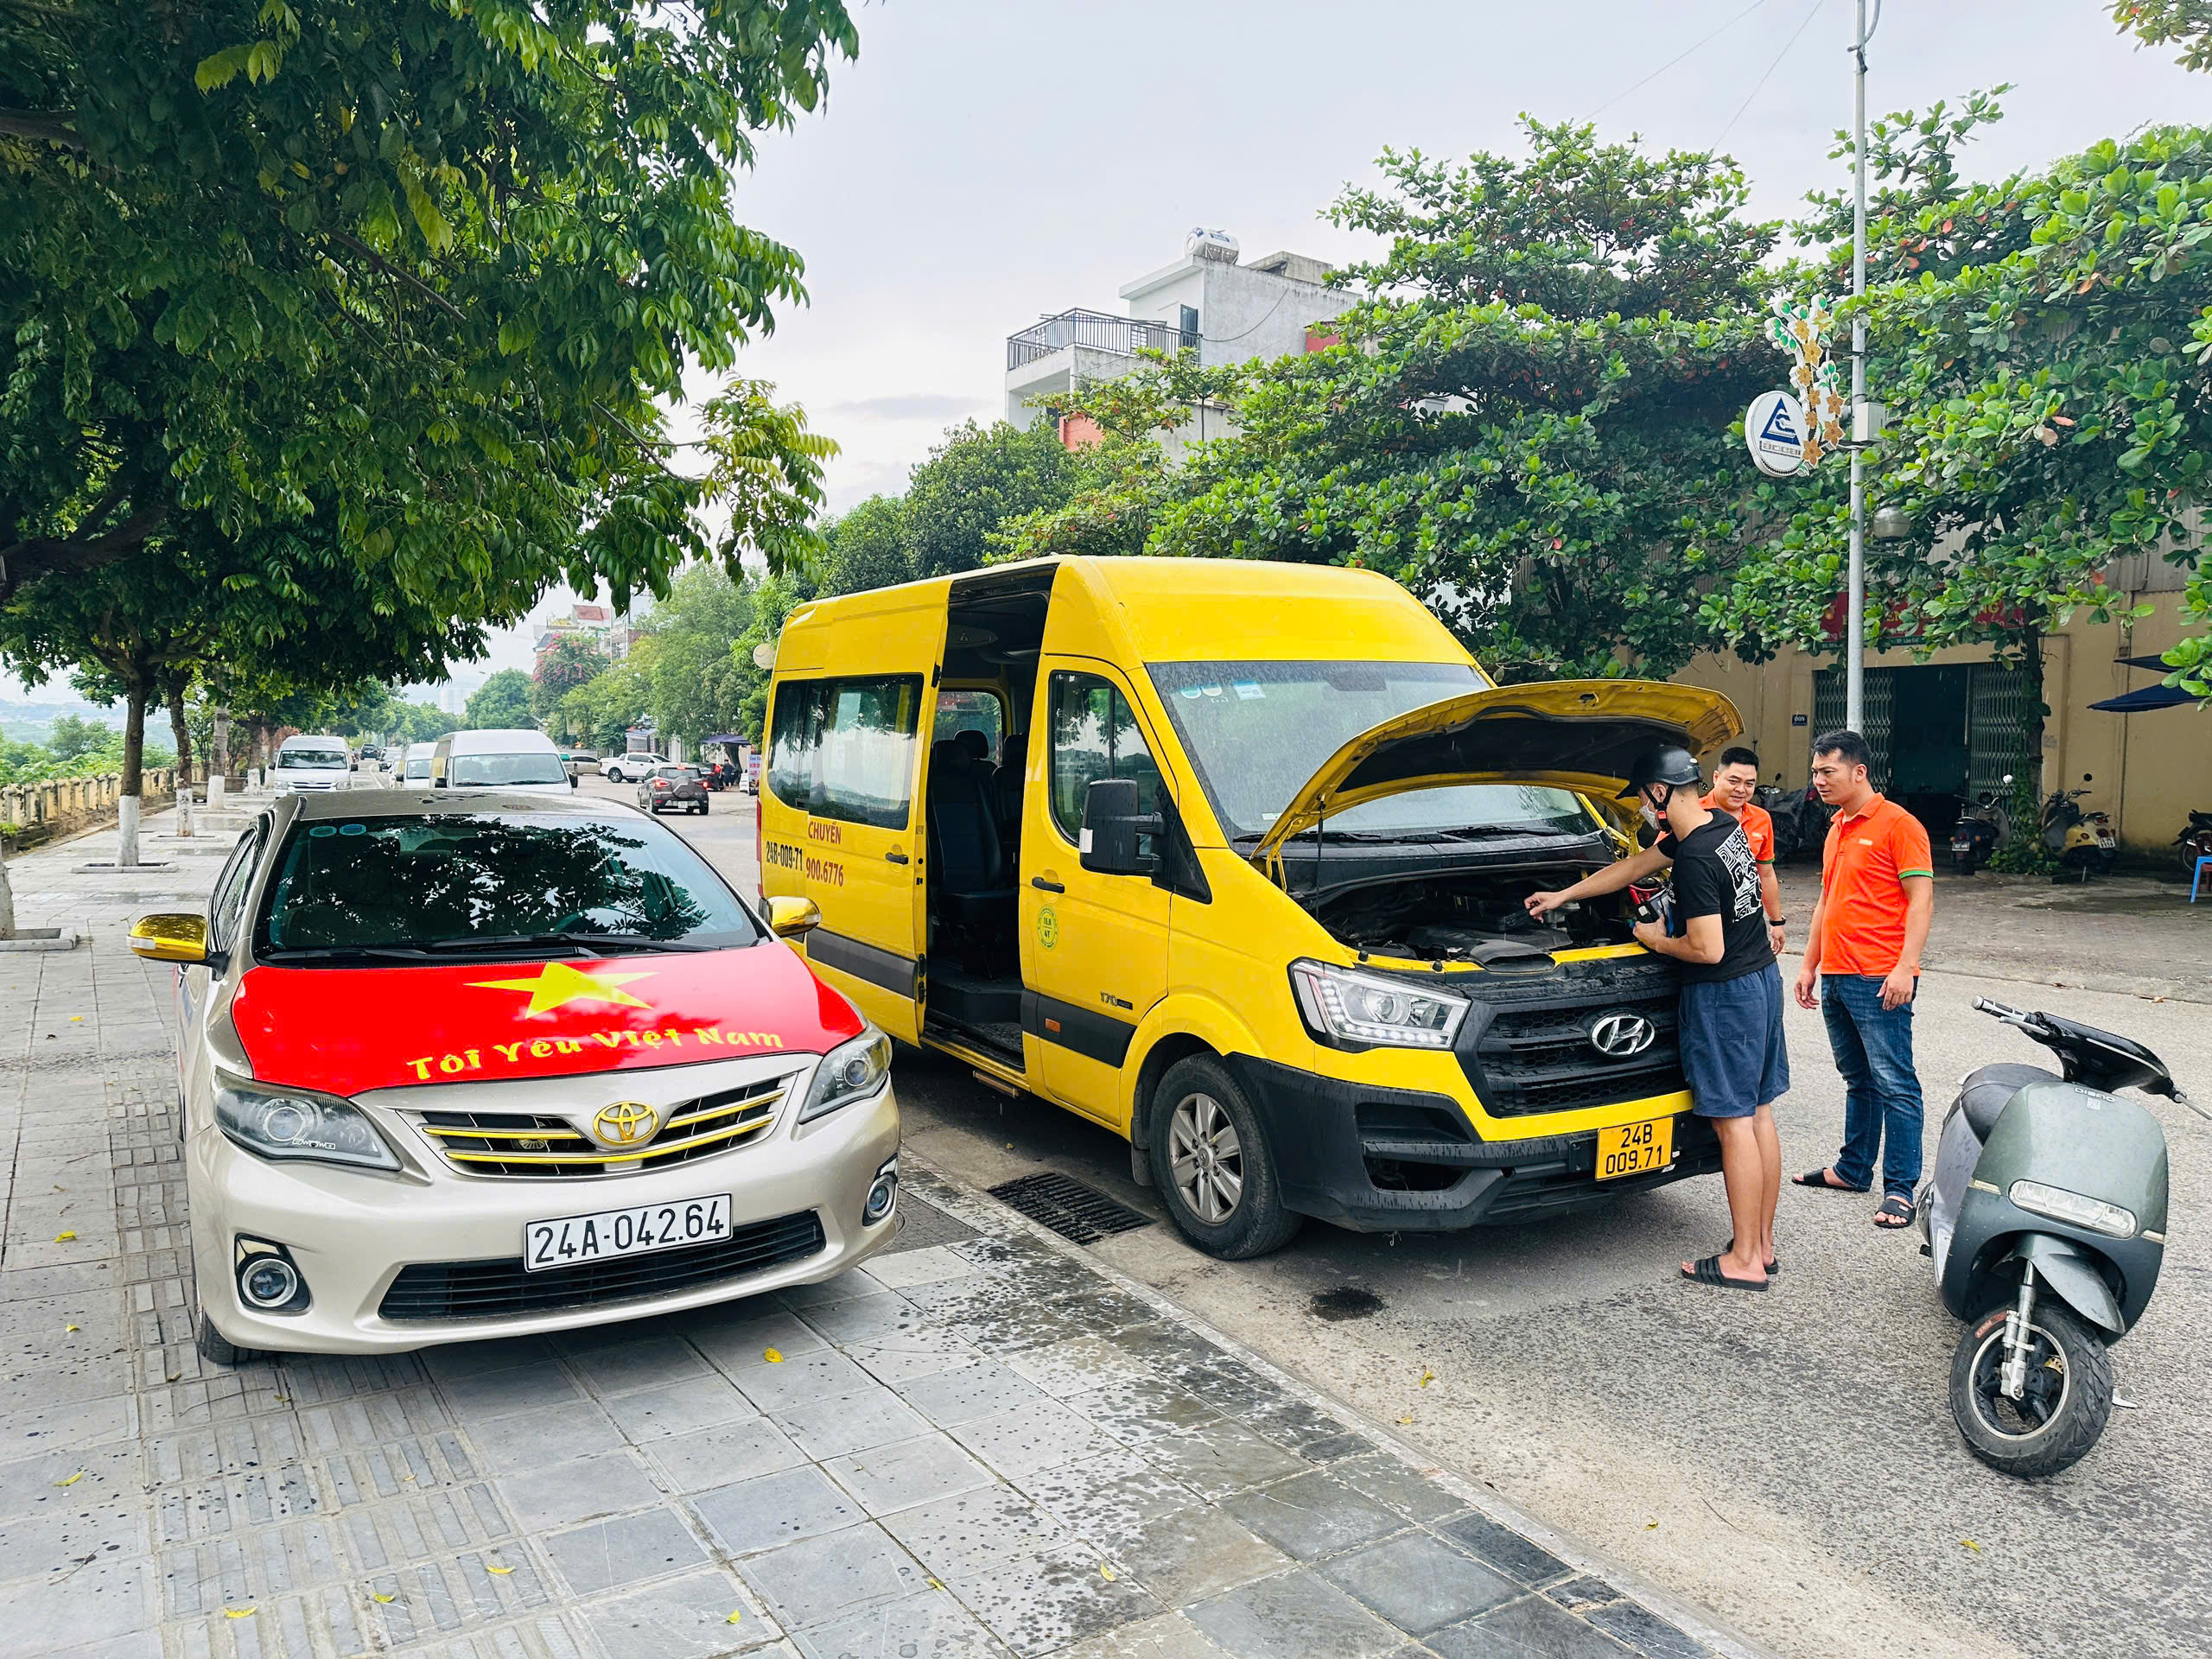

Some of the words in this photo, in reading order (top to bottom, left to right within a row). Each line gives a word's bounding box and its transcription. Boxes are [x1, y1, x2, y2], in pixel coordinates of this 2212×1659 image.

[806, 857, 843, 887] 900.6776
[407, 1050, 480, 1080] Tôi
[493, 1039, 582, 1063] Yêu
[591, 1028, 683, 1050] Việt
[692, 1027, 784, 1048] Nam
[1620, 1123, 1653, 1148] 24B
[1605, 1145, 1662, 1174] 009.71
[534, 1201, 724, 1264] 24A-042.64
